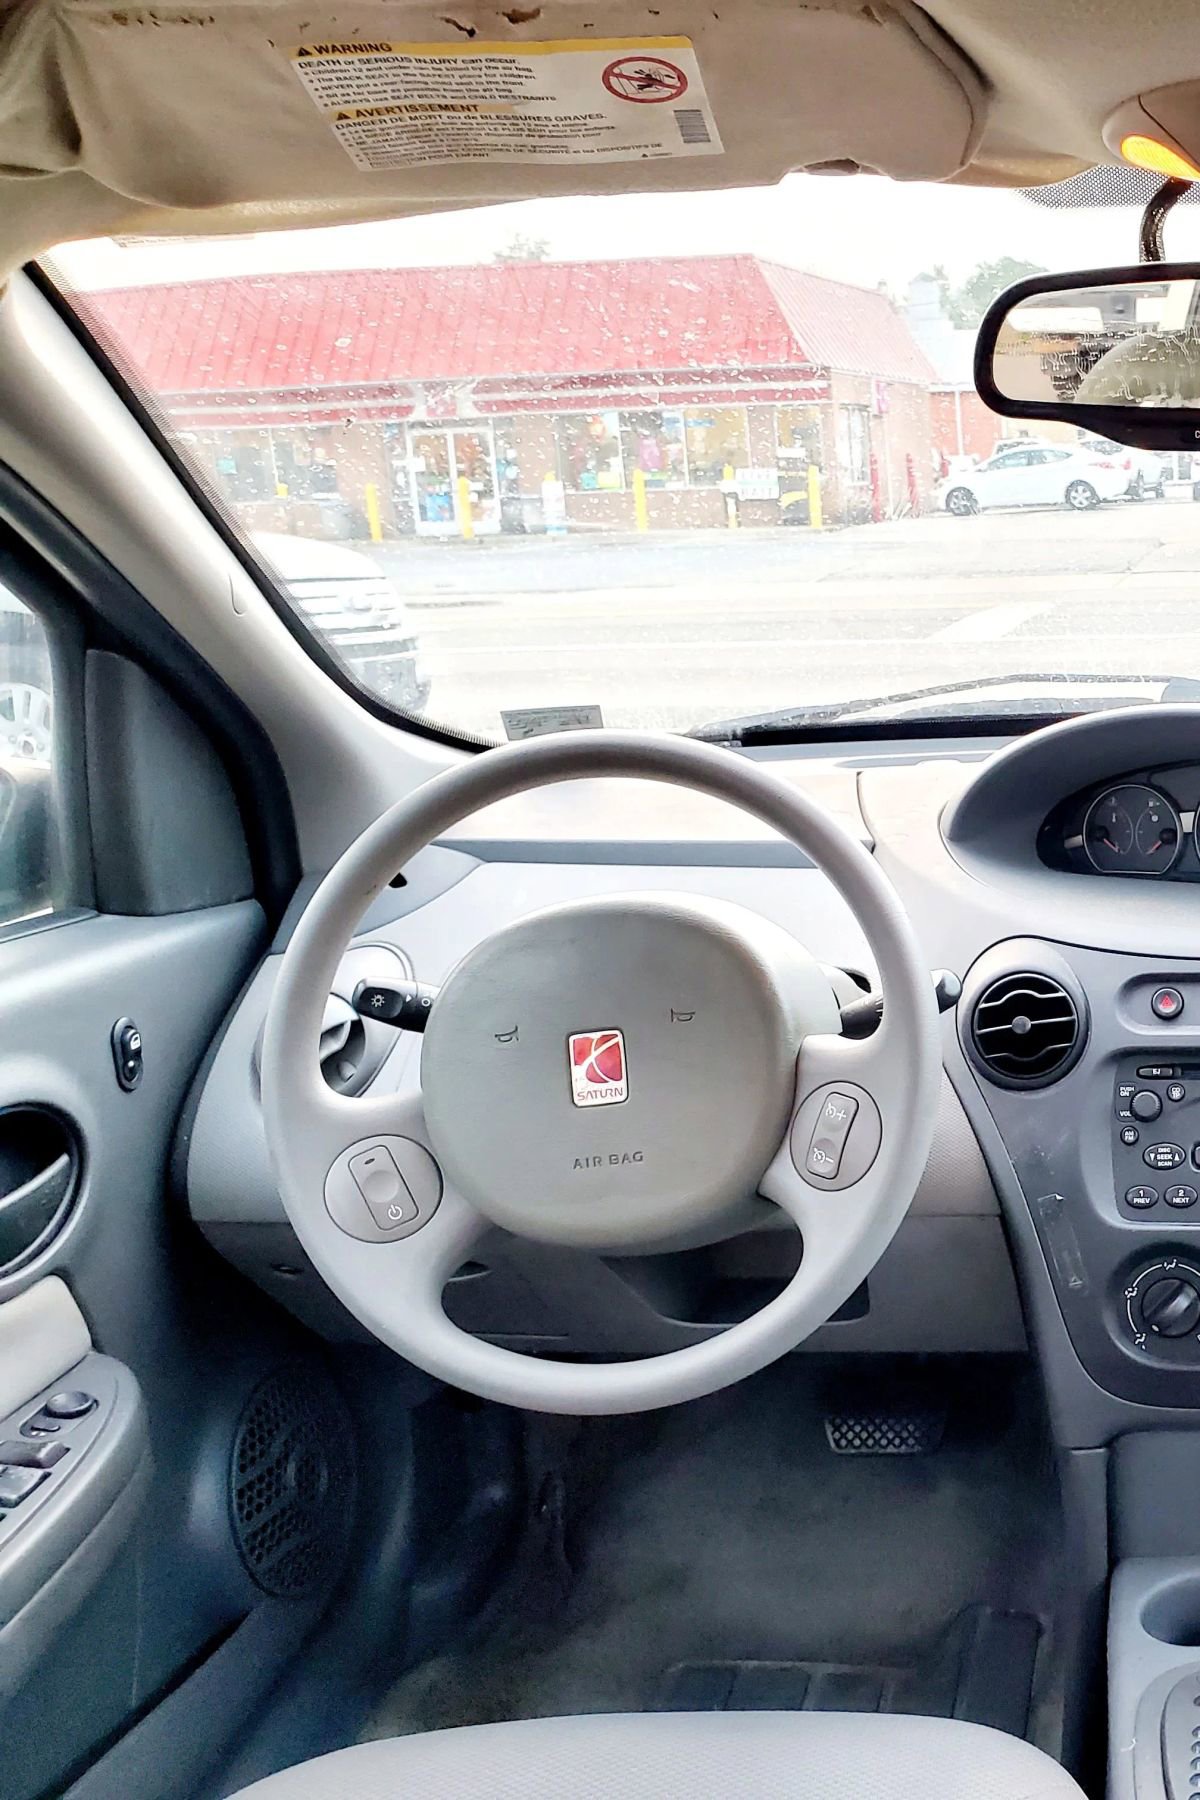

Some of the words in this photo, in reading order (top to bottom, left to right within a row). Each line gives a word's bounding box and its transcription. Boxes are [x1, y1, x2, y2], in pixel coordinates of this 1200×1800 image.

[313, 43, 392, 55] WARNING
[298, 58, 342, 69] DEATH
[357, 57, 412, 65] SERIOUS
[355, 104, 480, 118] AVERTISSEMENT
[335, 119, 388, 130] DANGER
[479, 114, 552, 122] BLESSURES
[576, 1087, 624, 1101] SATURN
[573, 1156, 602, 1170] AIR
[609, 1151, 645, 1165] BAG
